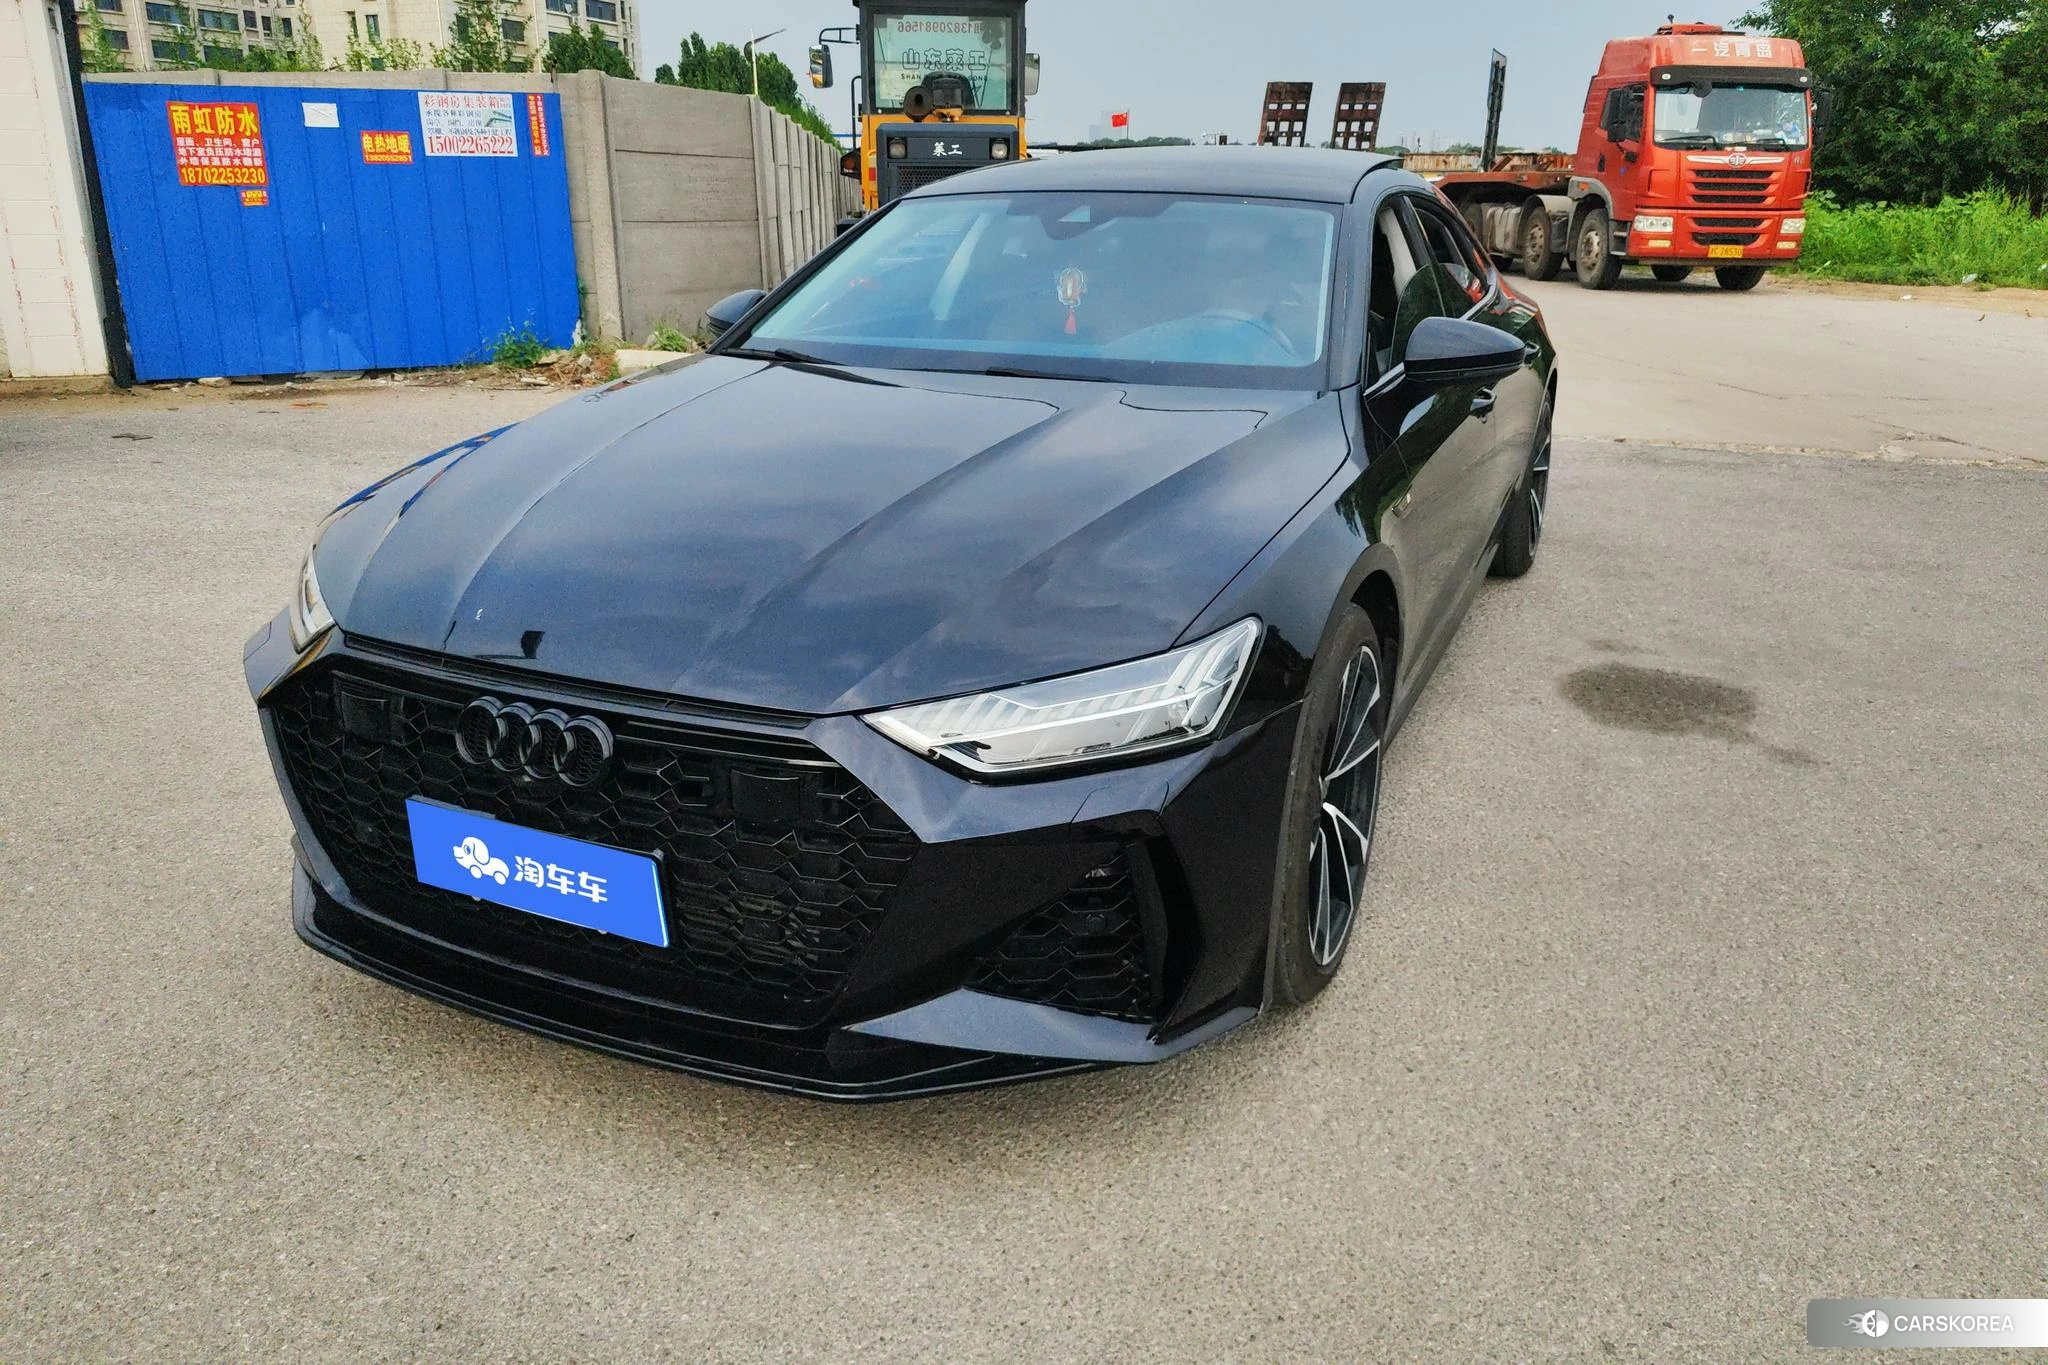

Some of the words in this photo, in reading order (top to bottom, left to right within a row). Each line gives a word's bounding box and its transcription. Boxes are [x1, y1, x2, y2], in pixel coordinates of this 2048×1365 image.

[902, 47, 986, 71] 山东莱工
[170, 105, 258, 136] 雨虹防水
[362, 133, 411, 153] 电热地暖
[429, 136, 514, 154] 15002265222
[932, 142, 963, 157] 莱工
[181, 167, 265, 184] 18702253230
